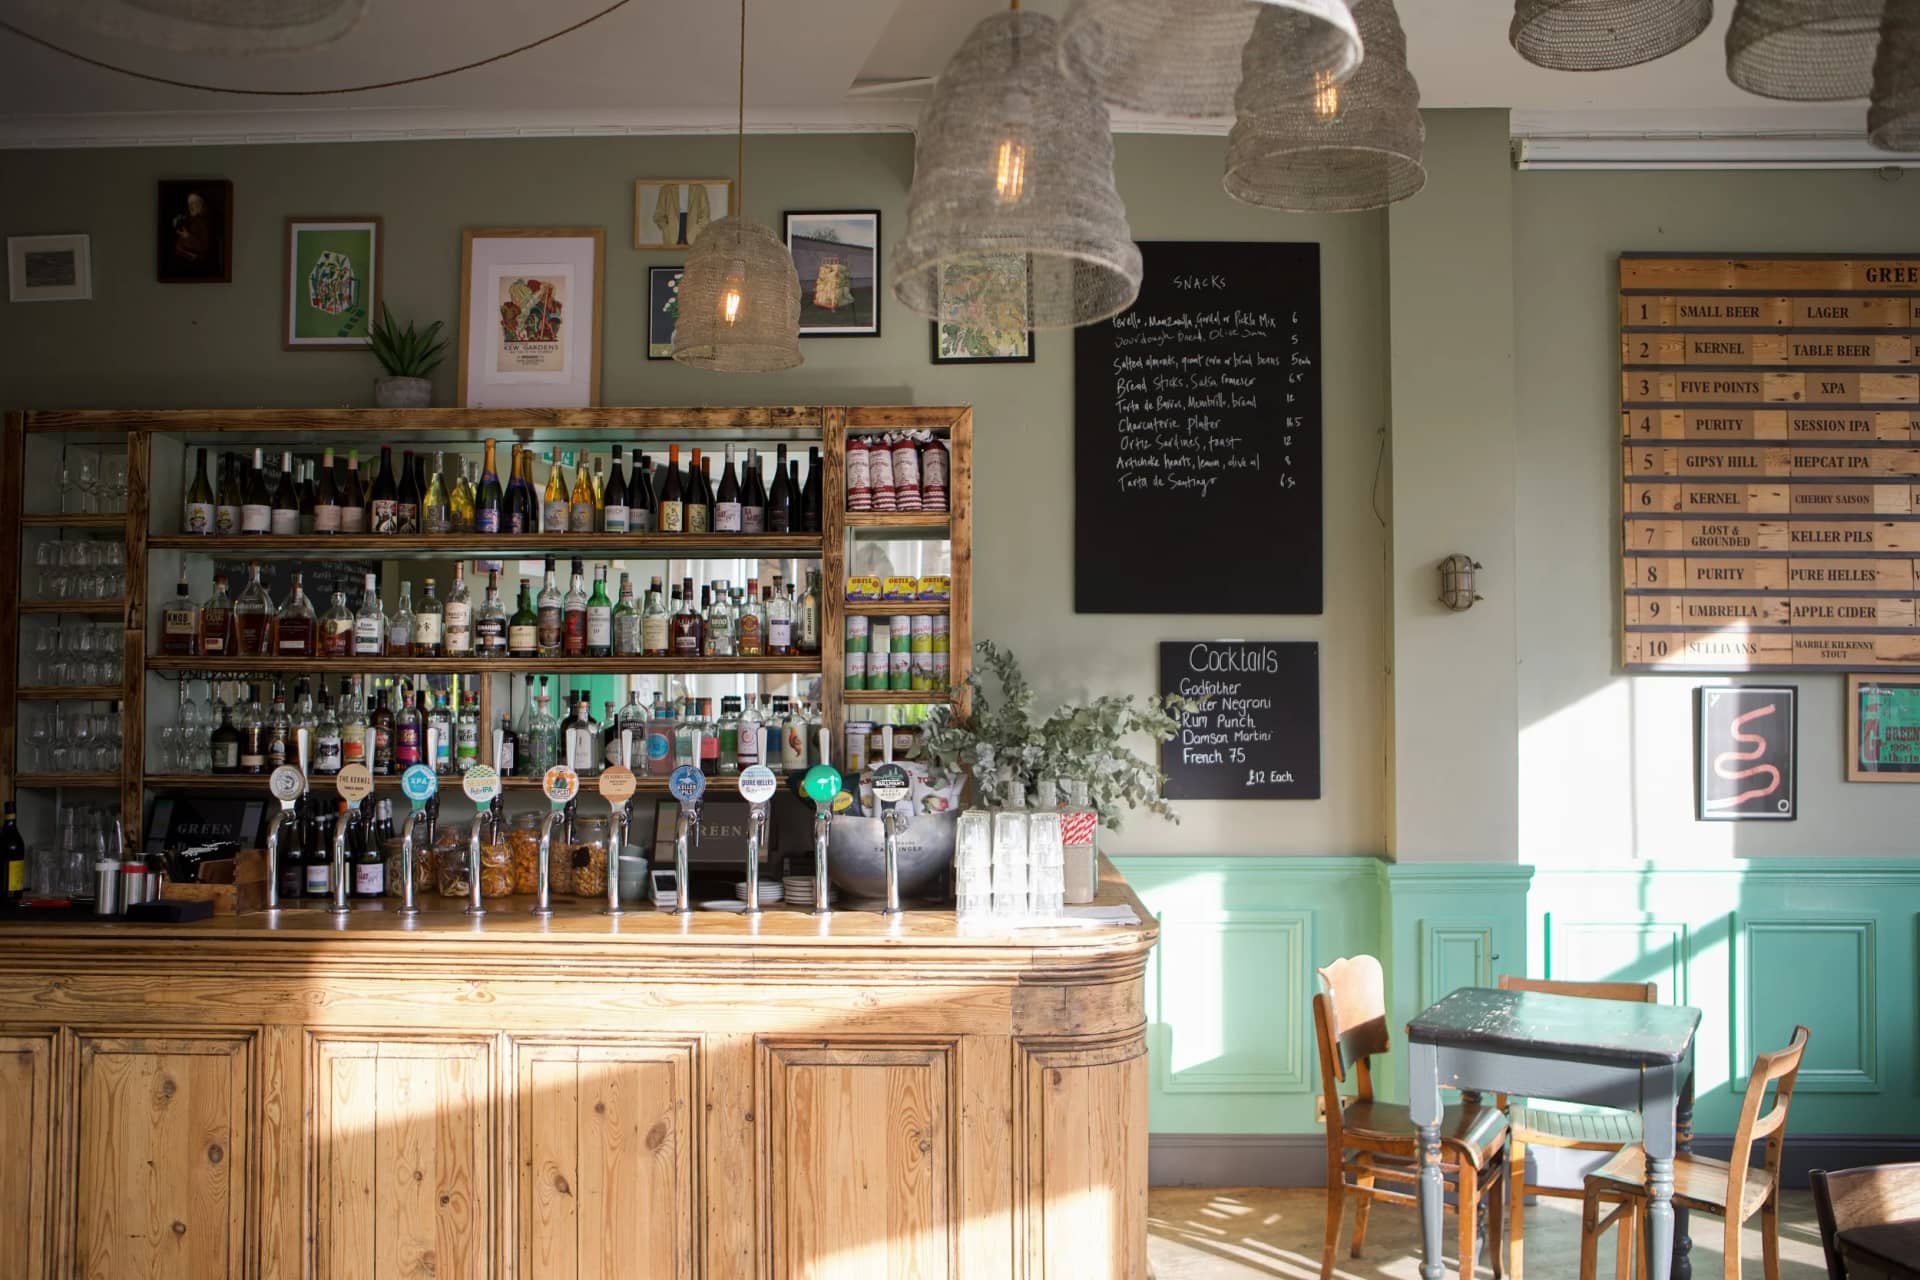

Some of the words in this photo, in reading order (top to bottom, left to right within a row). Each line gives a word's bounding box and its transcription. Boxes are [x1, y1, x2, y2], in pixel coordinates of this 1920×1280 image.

[1173, 274, 1228, 291] SNACKS
[1291, 312, 1299, 324] 6
[1639, 303, 1648, 320] 1
[1679, 306, 1723, 318] SMALL
[1725, 306, 1760, 318] BEER
[1807, 307, 1849, 319] LAGER
[1291, 334, 1299, 345] 5
[1640, 342, 1649, 359] 2
[1694, 342, 1745, 355] KERNEL
[1793, 344, 1834, 357] TABLE
[1836, 345, 1871, 357] BEER
[1640, 379, 1650, 396] 3
[1681, 381, 1710, 394] FIVE
[1713, 381, 1760, 394] POINTS
[1820, 382, 1846, 395] XPA
[1640, 416, 1651, 433] 4
[1695, 419, 1744, 432] PURITY
[1794, 420, 1845, 433] SESSION
[1848, 420, 1870, 433] IPA
[1643, 454, 1654, 470] 5
[1686, 456, 1724, 469] GIPSY
[1728, 456, 1758, 468] HILL
[1794, 456, 1845, 469] HEPCAT
[1848, 456, 1870, 468] IPA
[1641, 489, 1652, 506] 6
[1689, 493, 1741, 505] KERNEL
[1794, 494, 1834, 505] CHERRY
[1835, 494, 1870, 505] SAISON
[1645, 528, 1655, 545] 7
[1701, 525, 1730, 536] LOST
[1731, 526, 1740, 536] &
[1691, 536, 1751, 548] GROUNDED
[1791, 531, 1842, 544] KELLER
[1844, 531, 1873, 543] PILS
[1646, 566, 1658, 583] 8
[1697, 568, 1745, 581] PURITY
[1790, 568, 1825, 581] PURE
[1827, 568, 1876, 581] HELLES
[1650, 602, 1660, 618] 9
[1689, 605, 1758, 618] UMBRELLA
[1793, 606, 1833, 618] APPLE
[1836, 606, 1877, 618] CIDER
[1648, 641, 1668, 657] 10
[1689, 643, 1758, 655] SULLIVANS
[1795, 640, 1829, 650] MARBLE
[1830, 640, 1875, 650] KILKENNY
[1189, 643, 1279, 674] Cocktails
[1821, 651, 1848, 659] STOUT
[1179, 677, 1242, 696] Godfather
[1222, 697, 1272, 717] Negroni
[1181, 712, 1208, 729] Rum
[1217, 713, 1257, 729] Punch
[1183, 729, 1229, 745] Damson
[1234, 730, 1273, 743] Martini
[1183, 747, 1224, 764] French
[1228, 747, 1247, 764] 75
[410, 777, 428, 785] XPA
[742, 779, 756, 787] PURE
[757, 778, 775, 787] HELLES
[1245, 769, 1266, 787] £12
[1270, 770, 1294, 783] Each
[677, 783, 697, 791] KELLER
[177, 823, 233, 835] GREEN
